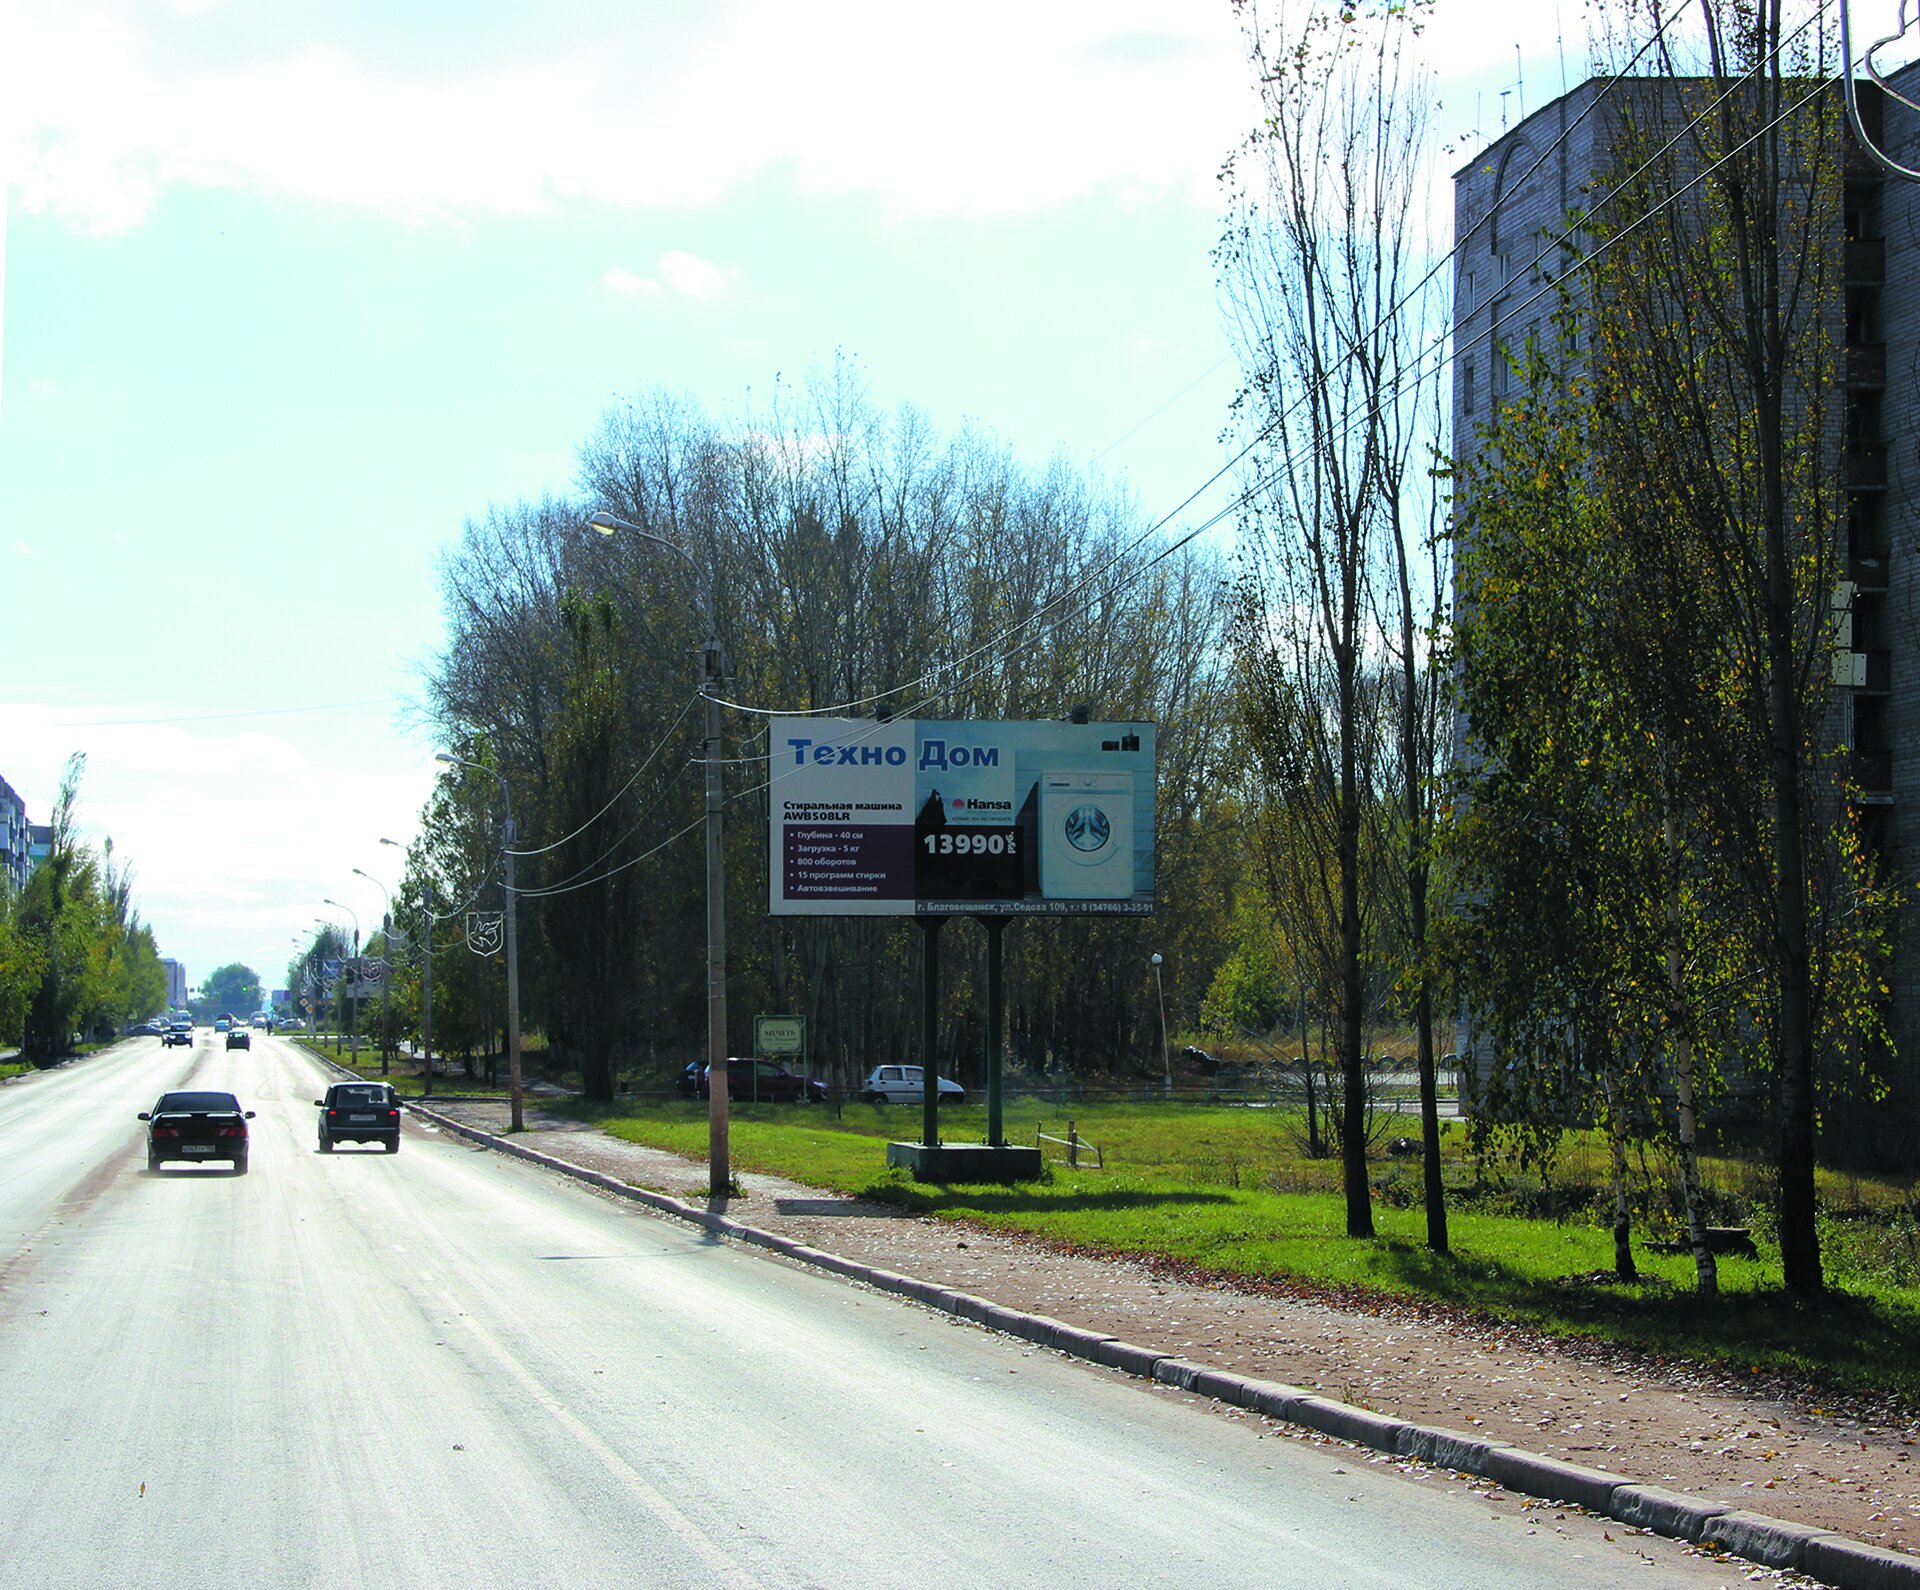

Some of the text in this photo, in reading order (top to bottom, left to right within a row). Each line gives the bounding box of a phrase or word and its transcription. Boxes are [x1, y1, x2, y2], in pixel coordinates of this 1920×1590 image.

[787, 738, 1000, 771] Техно Дом
[783, 801, 902, 811] Стиральная машина
[967, 799, 1012, 810] Hansa
[783, 812, 850, 821] AWB508LR
[797, 831, 833, 840] Глубина
[840, 831, 850, 839] 40
[924, 832, 1016, 855] 13990 руб.
[797, 845, 836, 854] Загрузка
[797, 858, 857, 867] 800 оборотов
[798, 871, 886, 881] 15 программ стирки
[797, 884, 878, 892] Автовзвешивание
